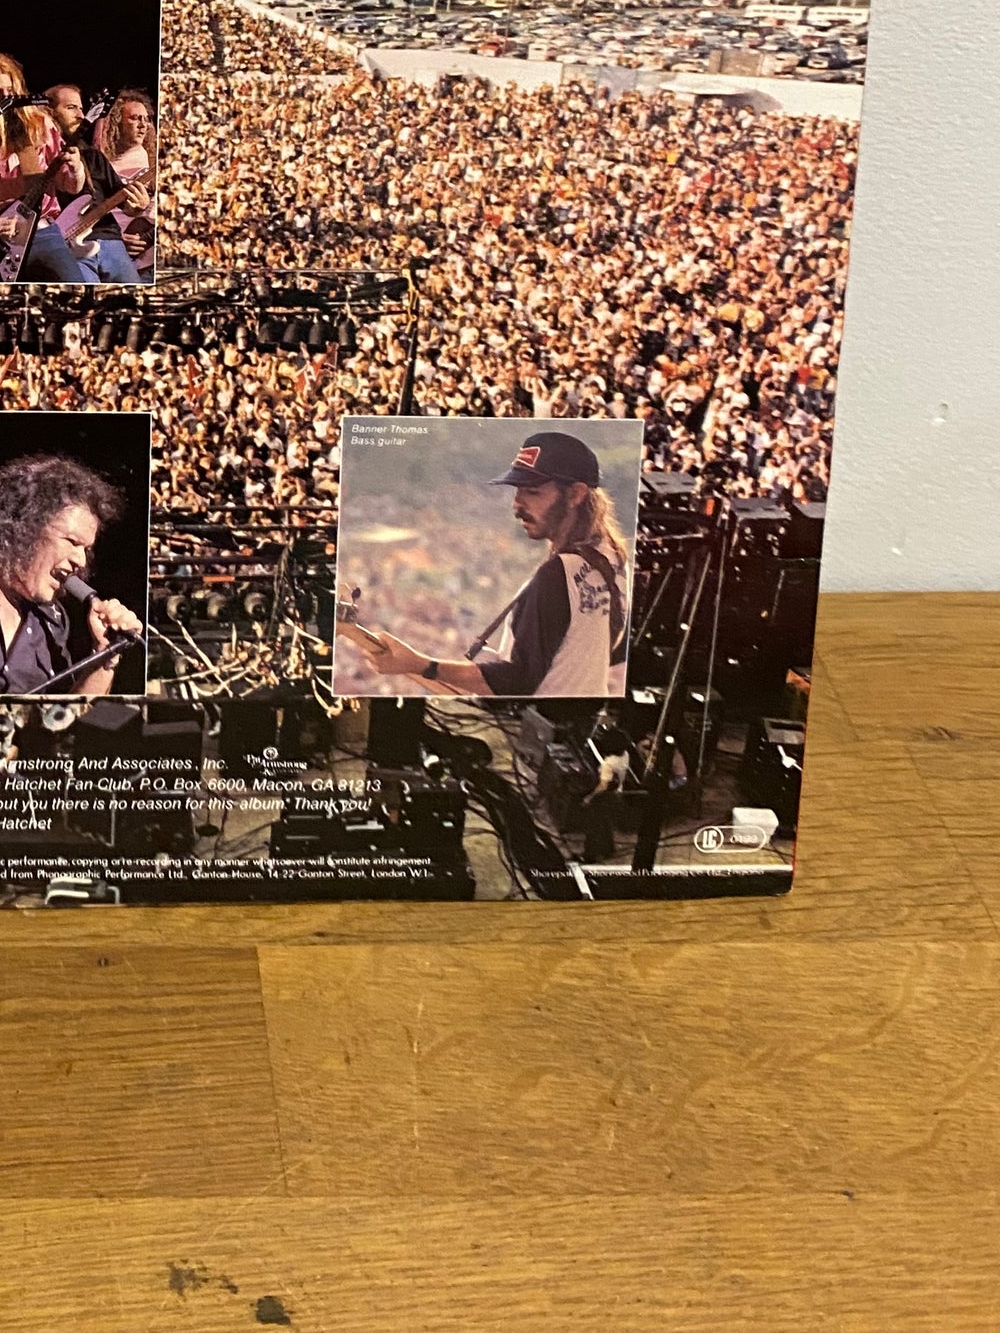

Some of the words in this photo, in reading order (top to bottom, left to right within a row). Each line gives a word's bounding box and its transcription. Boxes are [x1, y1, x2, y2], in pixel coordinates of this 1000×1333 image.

[351, 424, 387, 434] Banner
[390, 424, 429, 434] Thomas
[350, 436, 375, 445] Bass
[377, 437, 406, 447] guitar
[78, 757, 108, 770] And
[203, 757, 229, 770] Inc.
[4, 778, 61, 791] Hatchet
[66, 778, 93, 791] Fan
[97, 777, 135, 792] Club,
[173, 778, 202, 791] Box
[208, 778, 247, 793] 6600,
[252, 778, 306, 792] Macon,
[311, 778, 334, 792] GA
[21, 800, 48, 813] you
[51, 797, 90, 810] there
[93, 797, 105, 810] is
[109, 799, 128, 810] no
[131, 799, 182, 810] reason
[185, 797, 205, 810] for
[208, 797, 234, 810] this
[294, 797, 337, 811] Thank
[340, 798, 372, 813] you!
